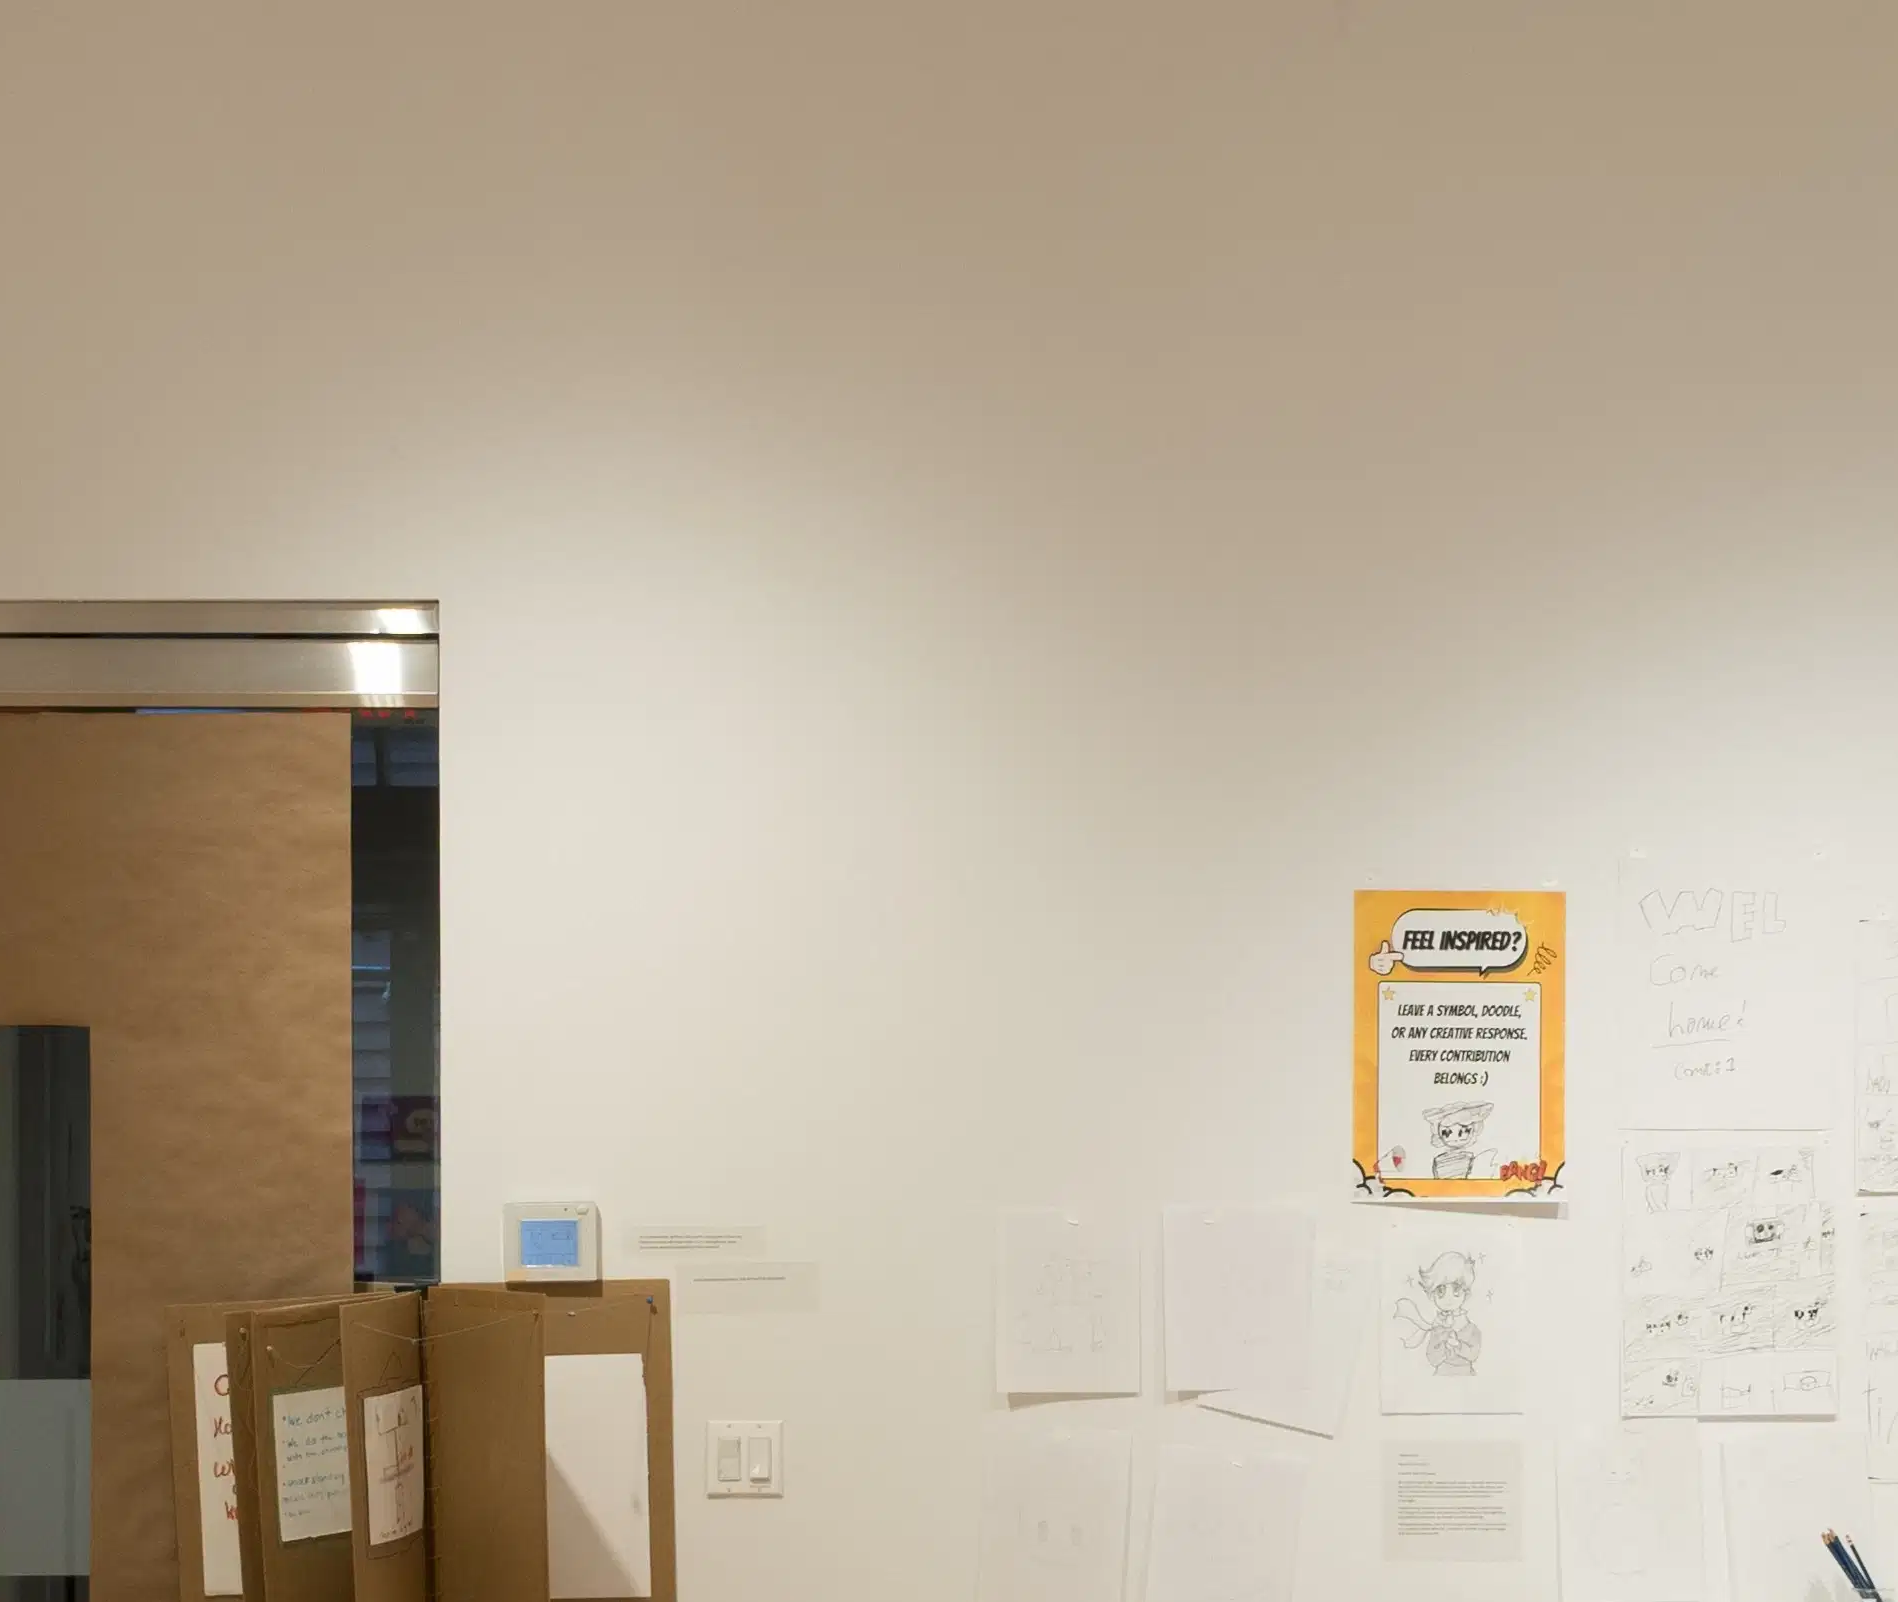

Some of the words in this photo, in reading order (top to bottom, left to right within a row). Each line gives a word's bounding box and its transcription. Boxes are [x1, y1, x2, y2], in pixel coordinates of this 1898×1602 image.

[1403, 930, 1435, 950] FEEL
[1439, 930, 1522, 951] INSPIRED?
[1398, 1004, 1425, 1016] LEAVE
[1427, 1004, 1434, 1016] A
[1437, 1004, 1478, 1018] SYMBOL,
[1481, 1004, 1522, 1018] DOODLE,
[1391, 1027, 1405, 1038] OR
[1408, 1027, 1427, 1038] ANY
[1430, 1027, 1473, 1039] CREATIVE
[1475, 1028, 1527, 1040] RESPONSE.
[1409, 1050, 1437, 1062] EVERY
[1440, 1050, 1510, 1062] CONTRIBUTION
[1433, 1072, 1478, 1084] BELONGS
[1480, 1071, 1489, 1086] :)
